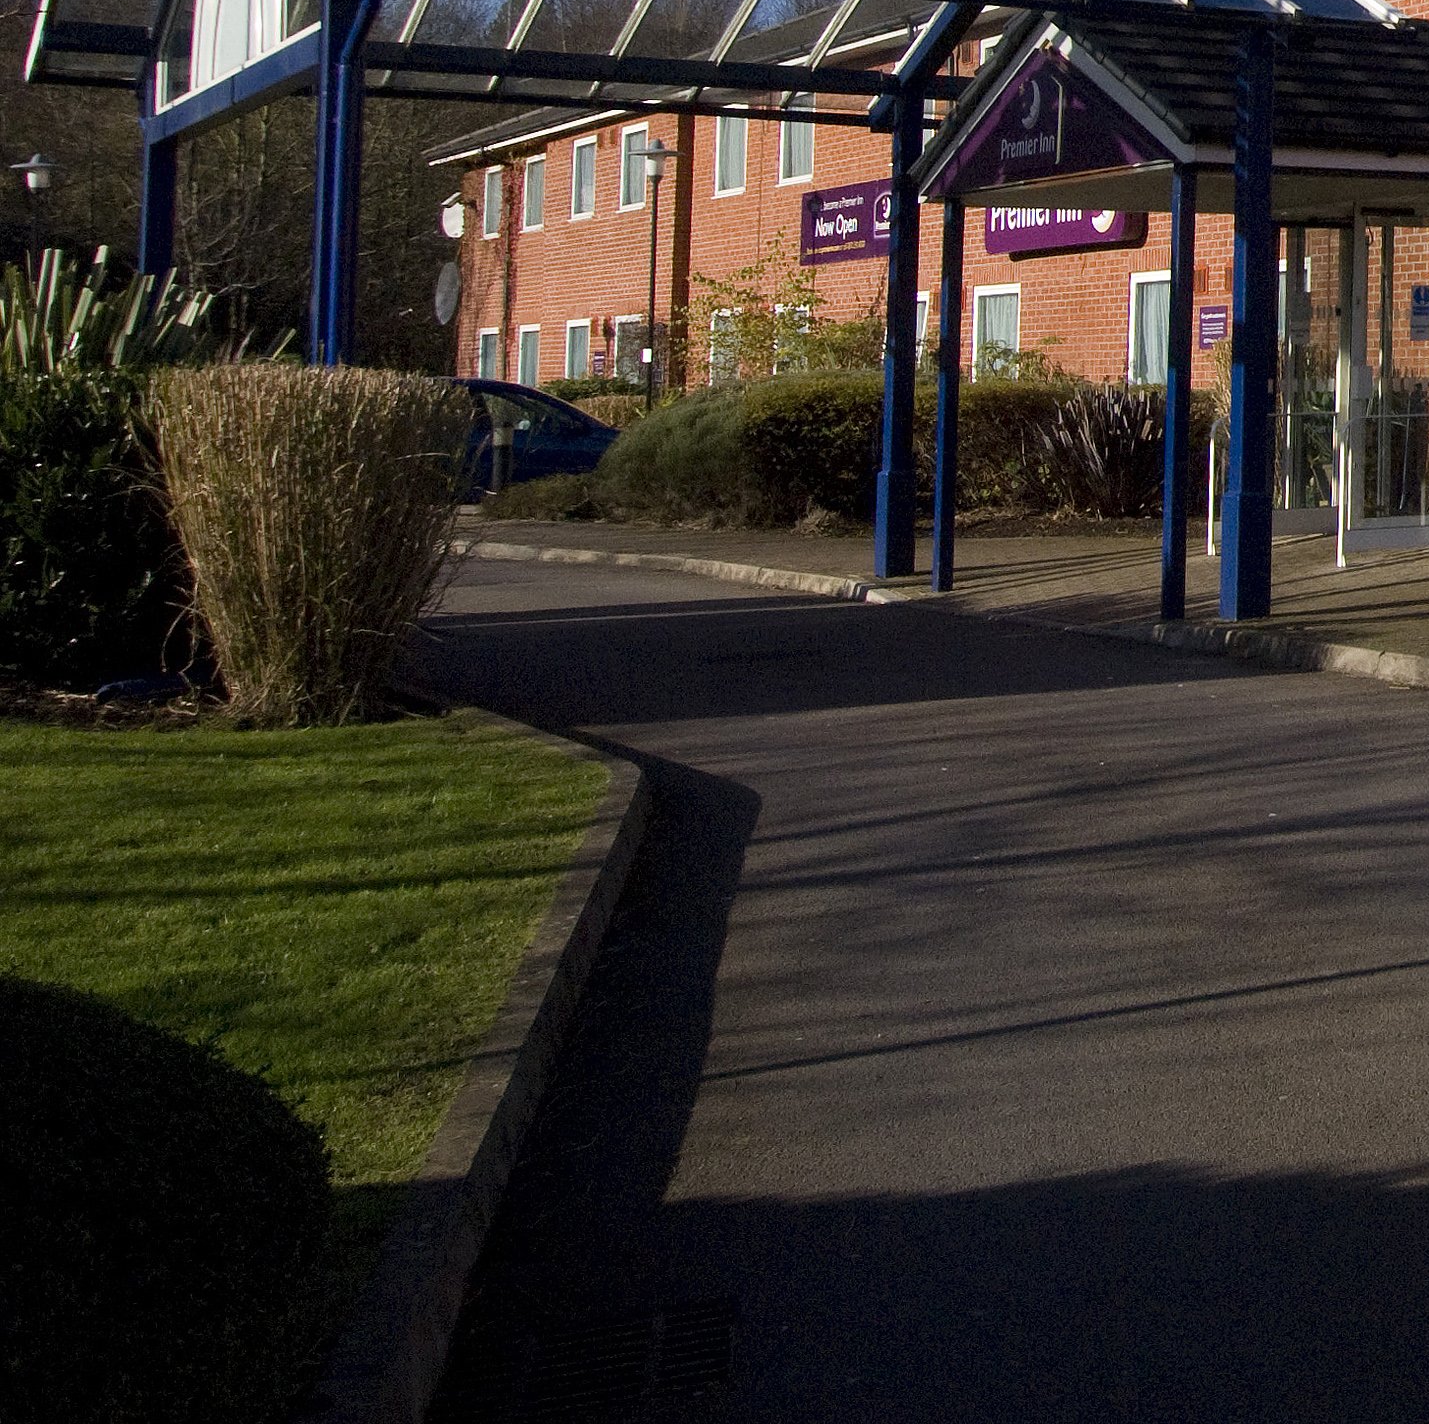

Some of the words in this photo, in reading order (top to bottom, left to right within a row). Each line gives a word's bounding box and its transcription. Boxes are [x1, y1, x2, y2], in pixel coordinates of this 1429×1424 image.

[1000, 134, 1039, 160] Premier
[1039, 132, 1055, 153] Inn
[815, 217, 835, 237] Now
[835, 213, 858, 240] Open
